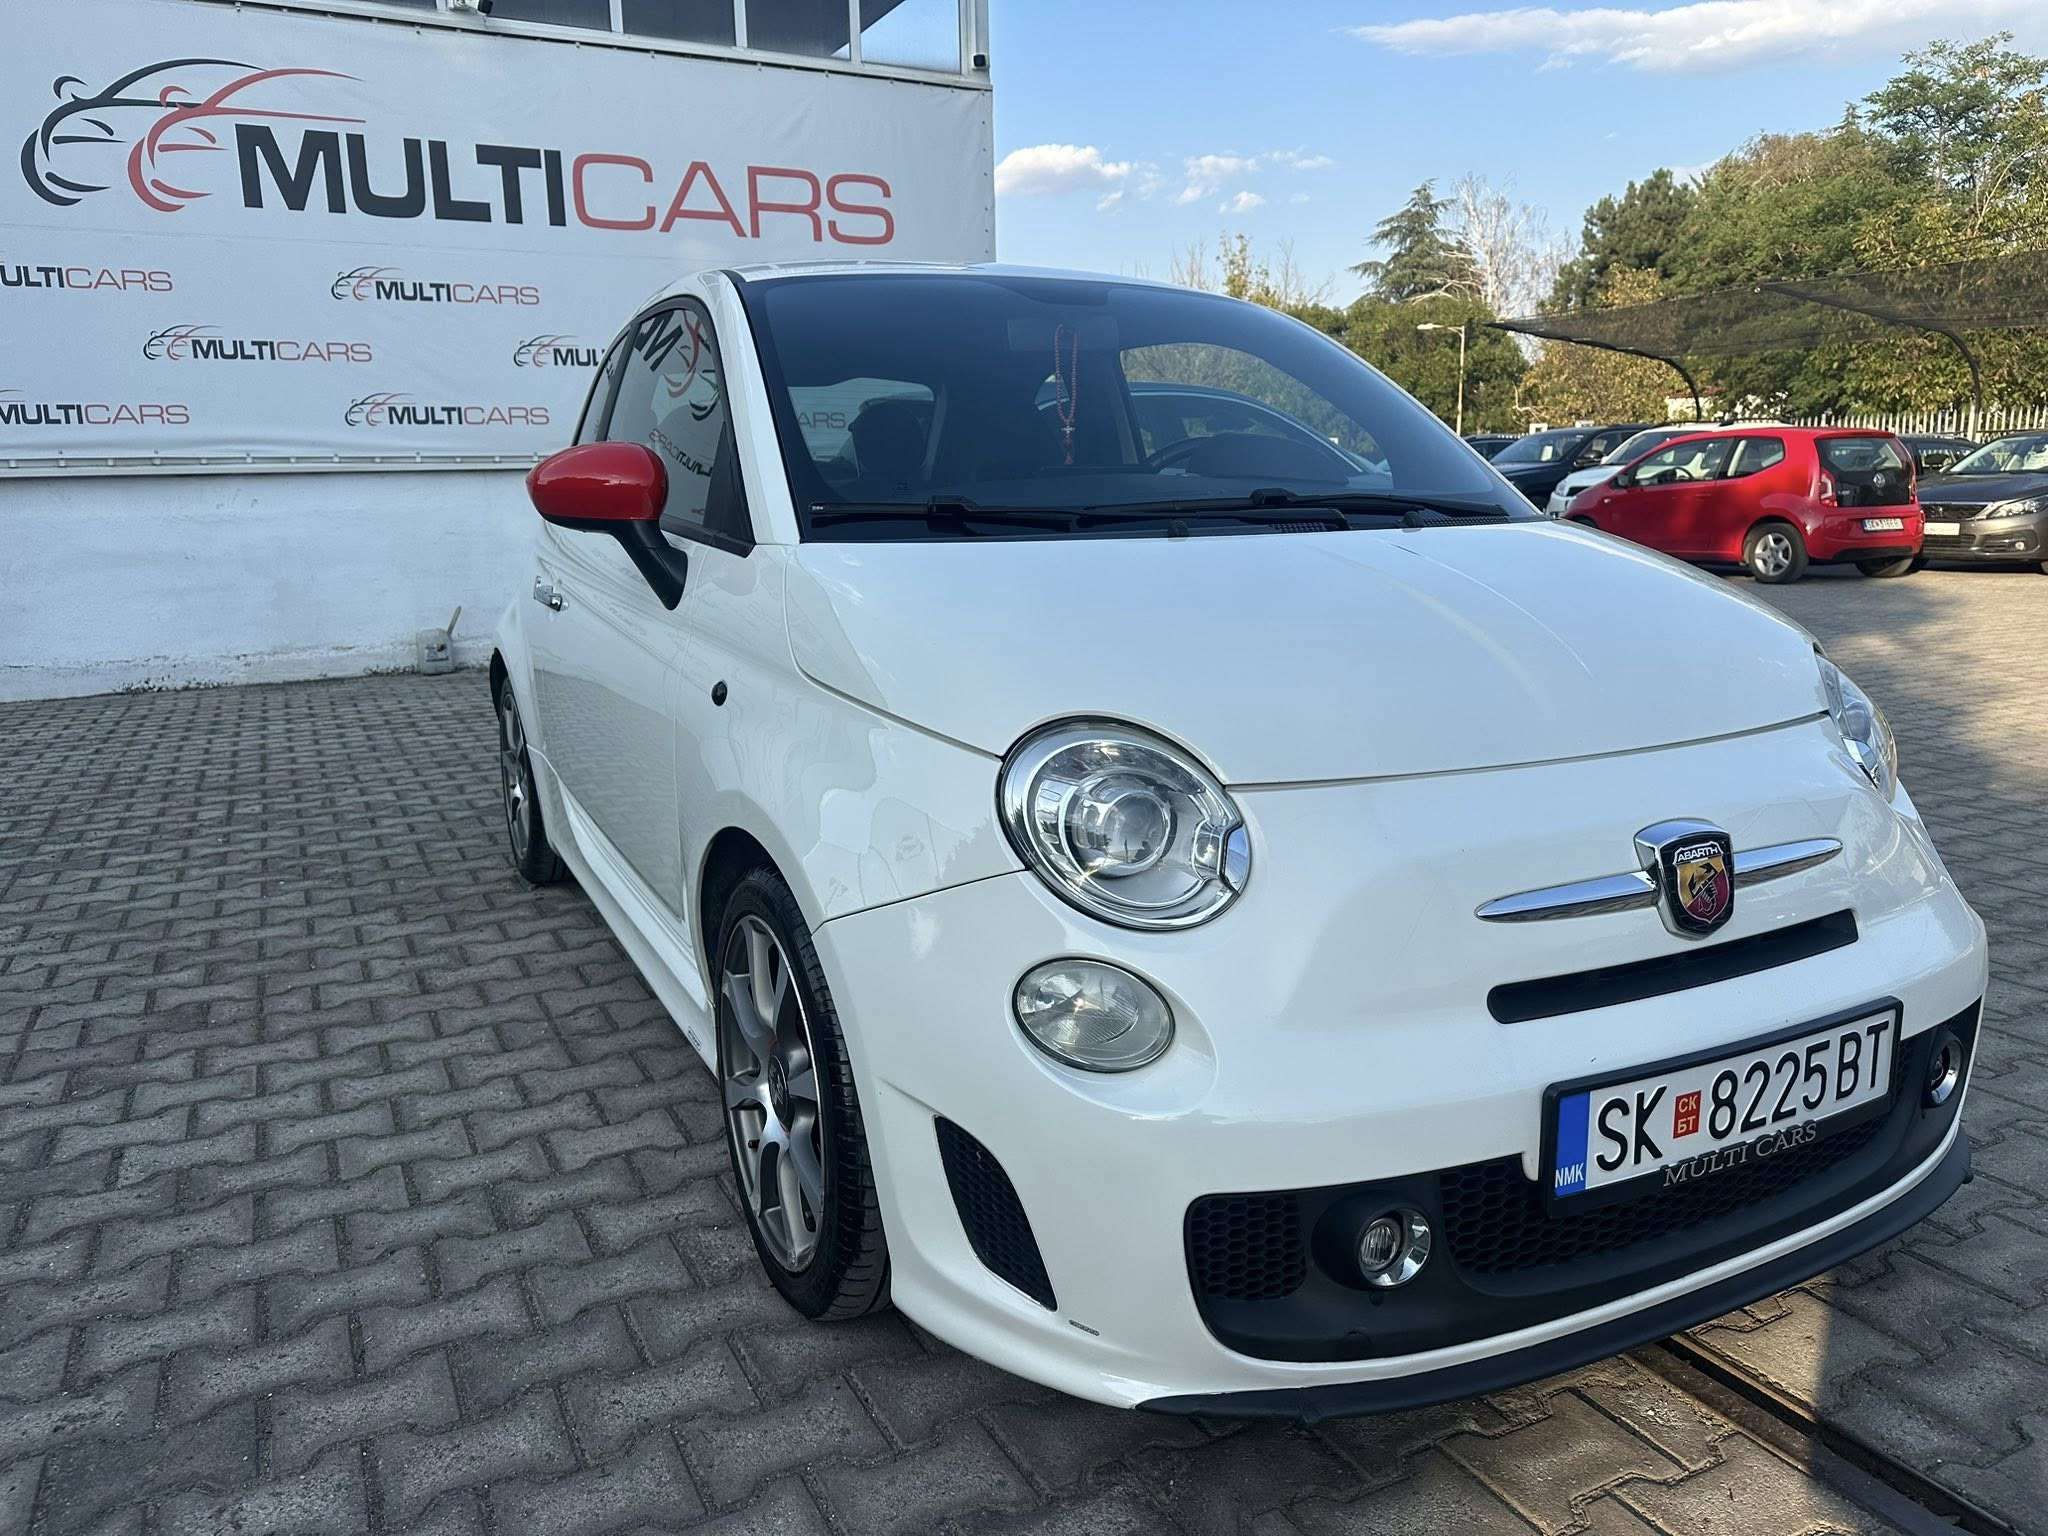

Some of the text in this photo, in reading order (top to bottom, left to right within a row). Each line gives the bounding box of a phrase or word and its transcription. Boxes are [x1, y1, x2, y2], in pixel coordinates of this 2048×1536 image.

[235, 122, 895, 246] MULTICARS
[376, 280, 539, 305] MULTICARS
[191, 339, 372, 362] MULTICARS
[388, 405, 549, 426] MULTICARS
[1677, 847, 1718, 861] ABARTH
[1595, 1085, 1667, 1171] SK
[1663, 1122, 1817, 1187] MULTI CARS
[1554, 1163, 1584, 1188] NMK
